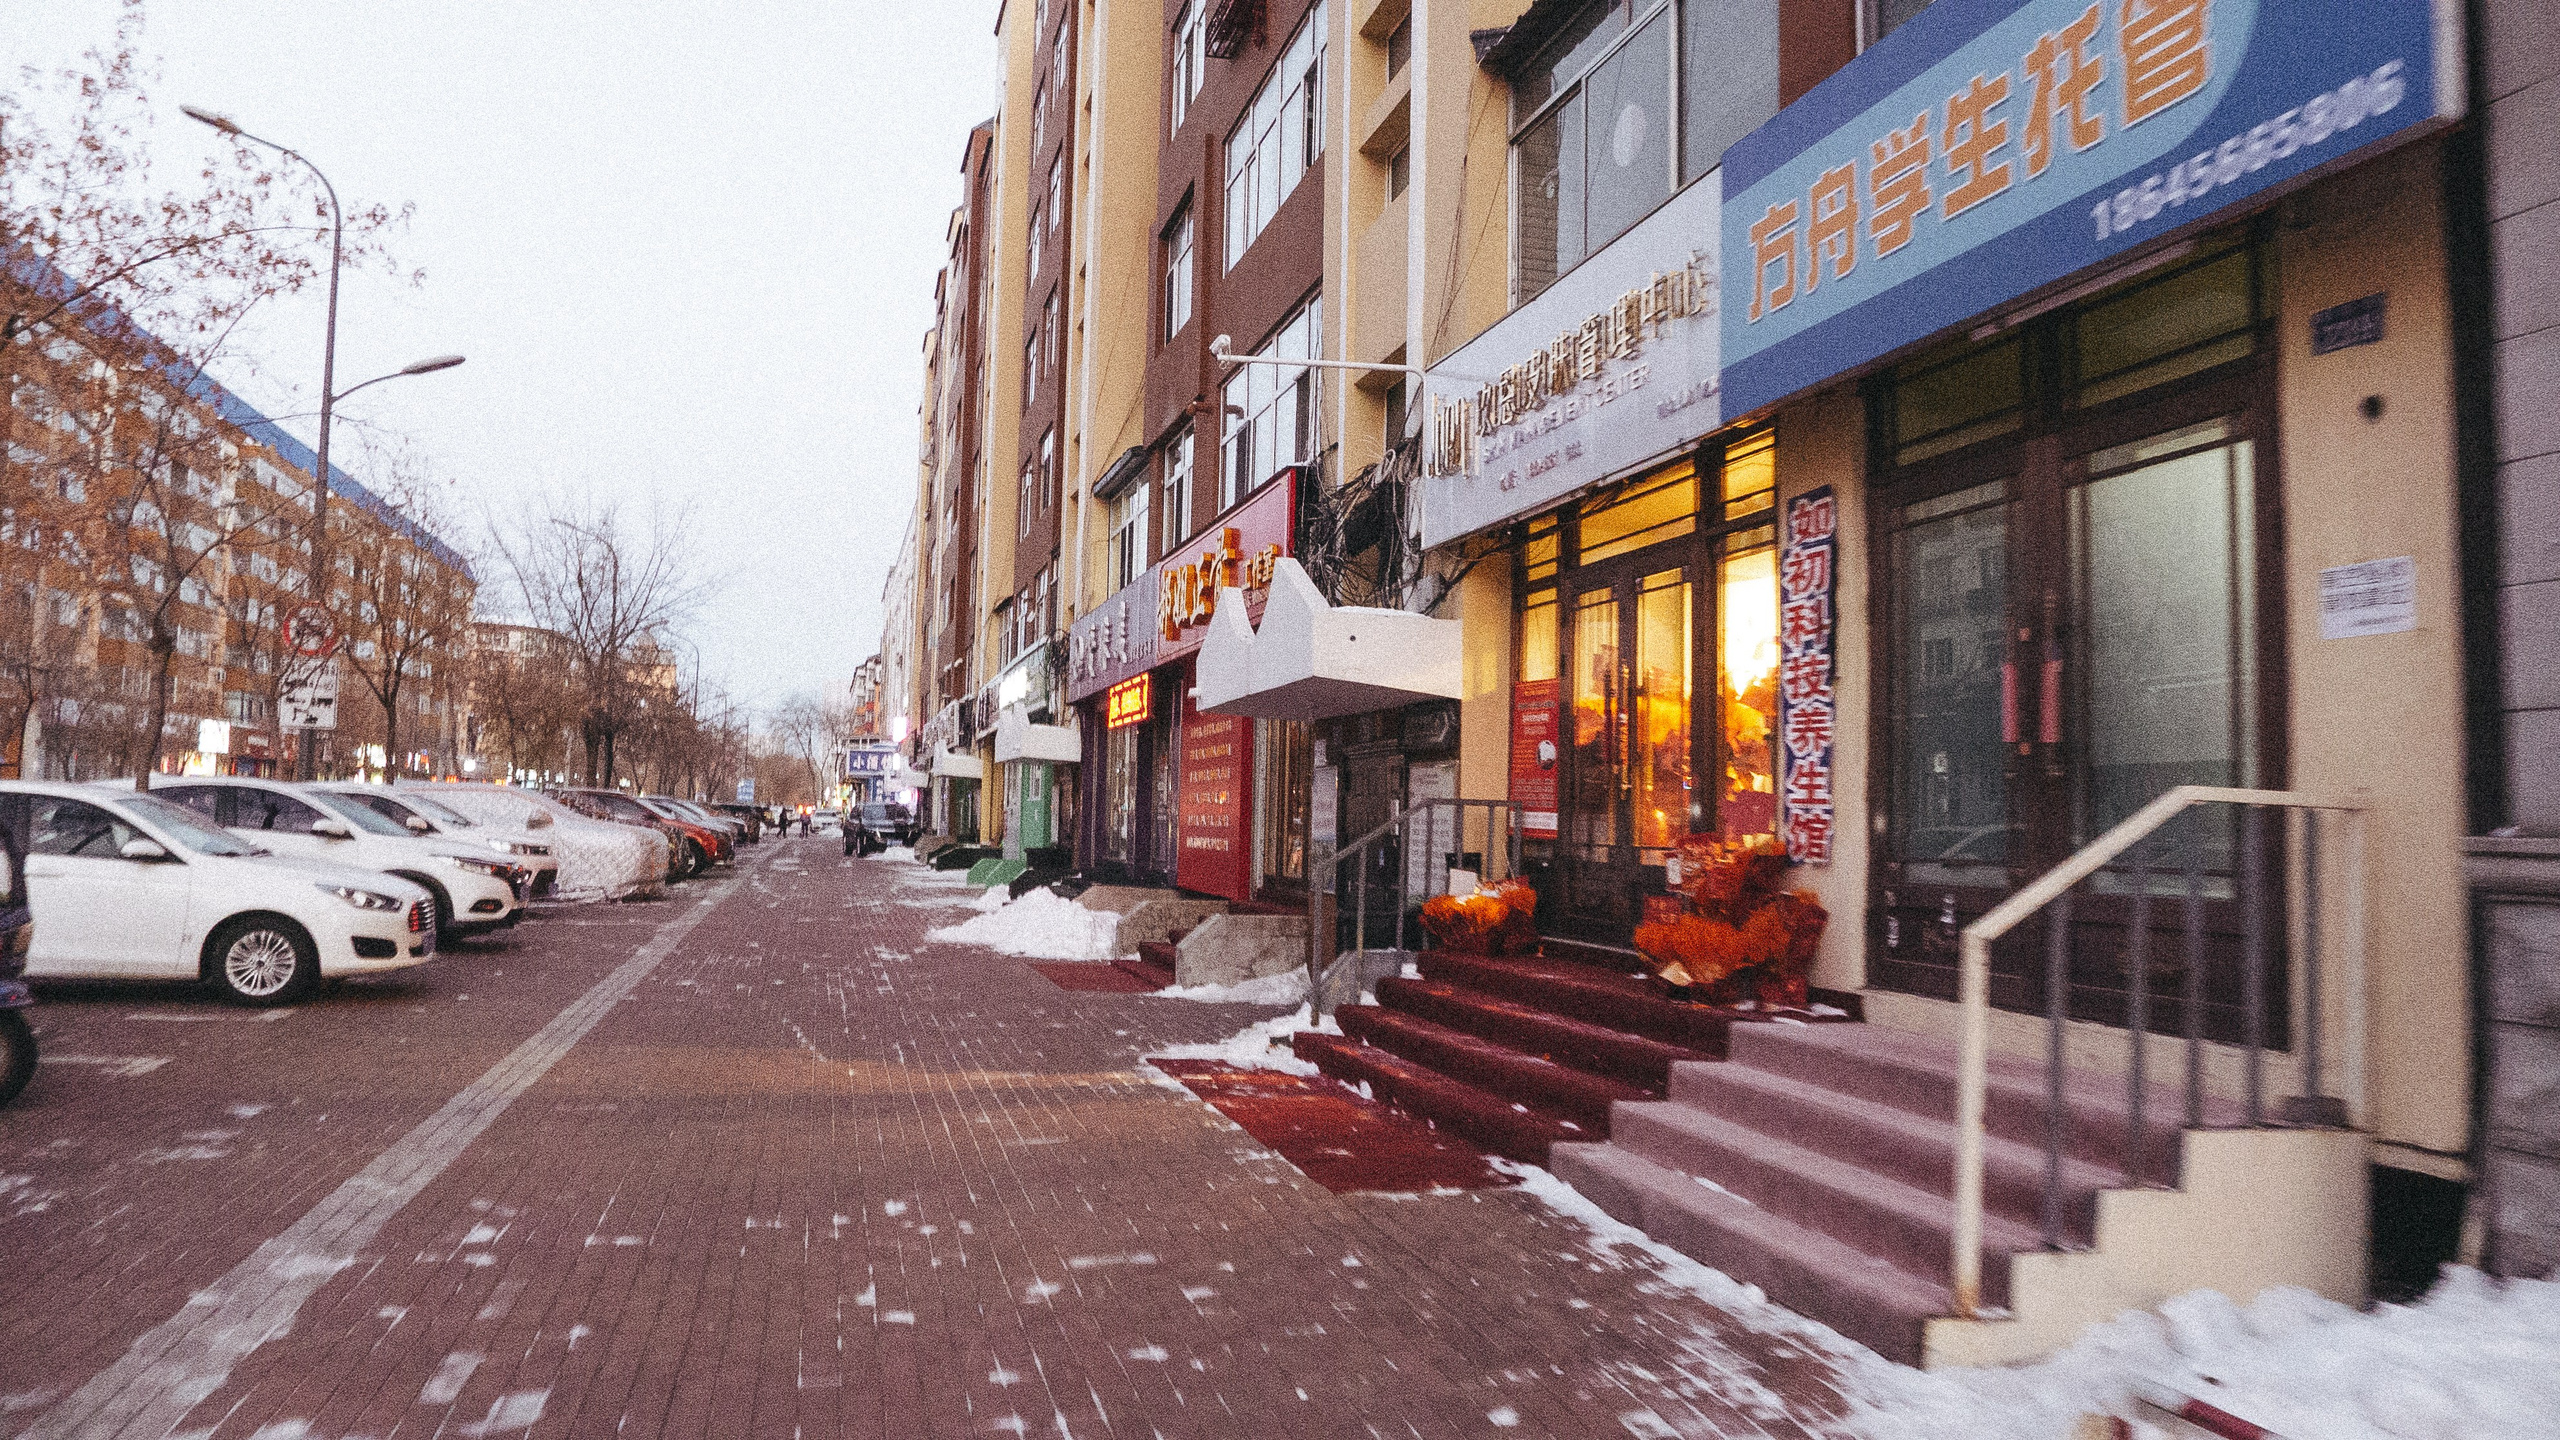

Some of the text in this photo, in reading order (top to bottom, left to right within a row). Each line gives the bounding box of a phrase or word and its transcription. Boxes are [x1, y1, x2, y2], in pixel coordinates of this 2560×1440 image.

[1747, 0, 2212, 324] 方舟学生托管
[1780, 493, 1835, 867] 如初科技养生馆
